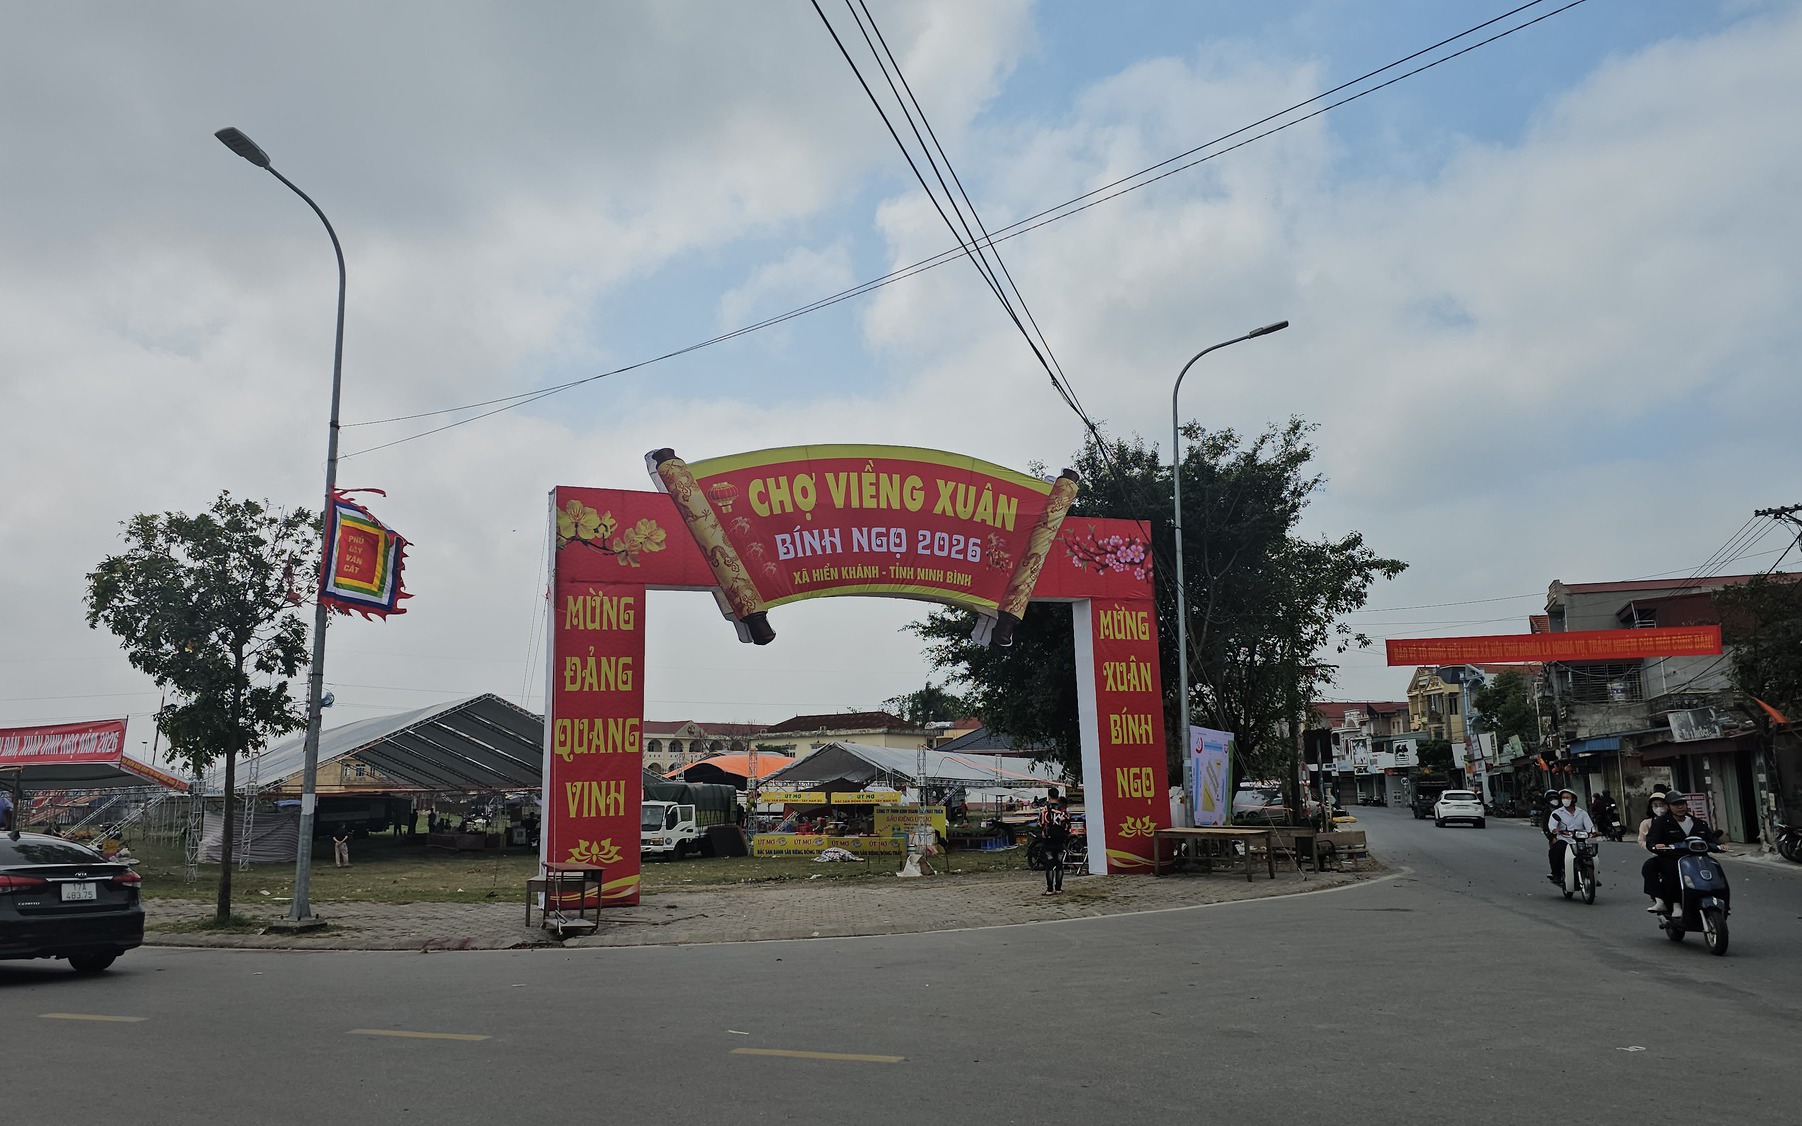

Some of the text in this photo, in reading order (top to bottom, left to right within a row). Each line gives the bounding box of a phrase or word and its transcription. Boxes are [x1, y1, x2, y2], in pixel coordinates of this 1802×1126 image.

[748, 459, 1018, 532] CHỢ VIỀNG XUÂN
[774, 525, 982, 563] BÍNH NGỌ 2026
[793, 569, 811, 585] XÃ
[812, 563, 839, 581] HIỂN
[841, 563, 879, 579] KHÁNH
[889, 563, 915, 580] TỈNH
[917, 567, 943, 582] NINH
[945, 570, 973, 587] BÌNH
[565, 588, 634, 631] MỪNG
[1099, 603, 1150, 641] MỪNG
[564, 645, 633, 692] ĐẢNG
[1103, 655, 1153, 692] XUÂN
[18, 731, 43, 756] XUÂN
[40, 730, 62, 755] BÍNH
[60, 733, 79, 759] NGỌ
[77, 728, 99, 754] NĂM
[96, 732, 119, 753] 2026
[554, 718, 640, 762] QUANG
[1110, 706, 1154, 745] BÍNH
[565, 780, 626, 818] VINH
[1116, 767, 1155, 805] NGỌ
